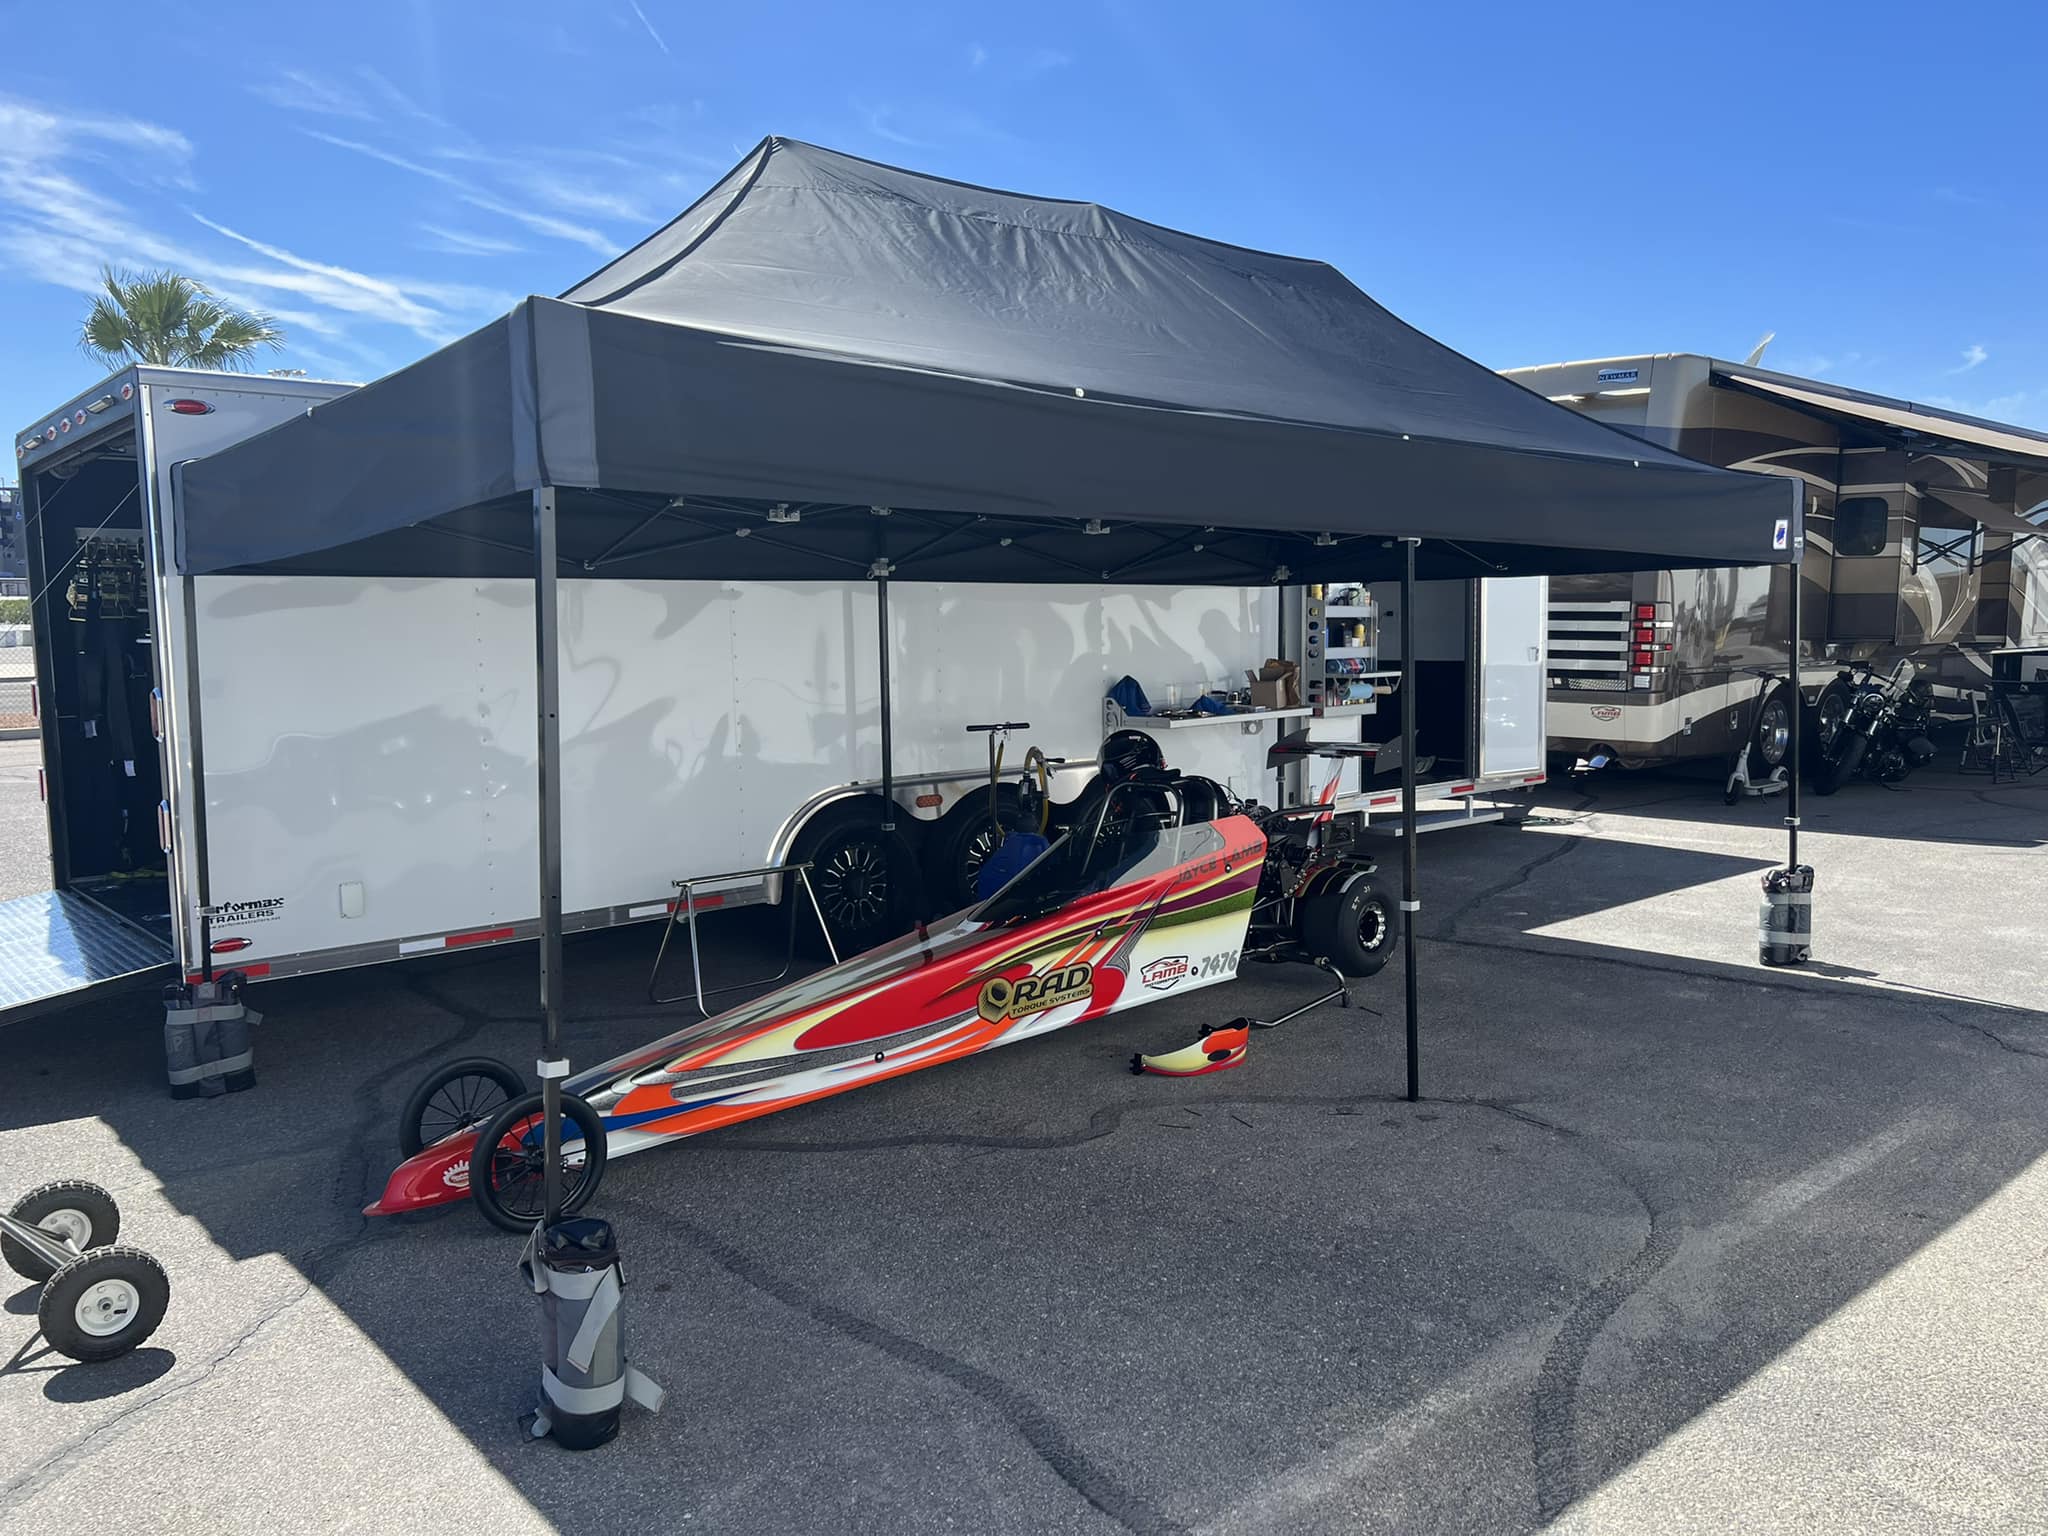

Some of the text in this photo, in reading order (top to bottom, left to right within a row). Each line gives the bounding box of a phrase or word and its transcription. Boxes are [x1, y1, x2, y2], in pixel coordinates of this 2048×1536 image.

[1599, 371, 1638, 381] NEWMAR
[1176, 839, 1264, 883] JAYCE LAMB
[209, 909, 275, 925] TRAILERS
[215, 897, 285, 914] rformax
[1142, 963, 1189, 985] LAMB
[1200, 949, 1238, 979] 7476
[1012, 966, 1090, 1006] RAD
[1012, 988, 1091, 1015] TORQUE SYSTEMS
